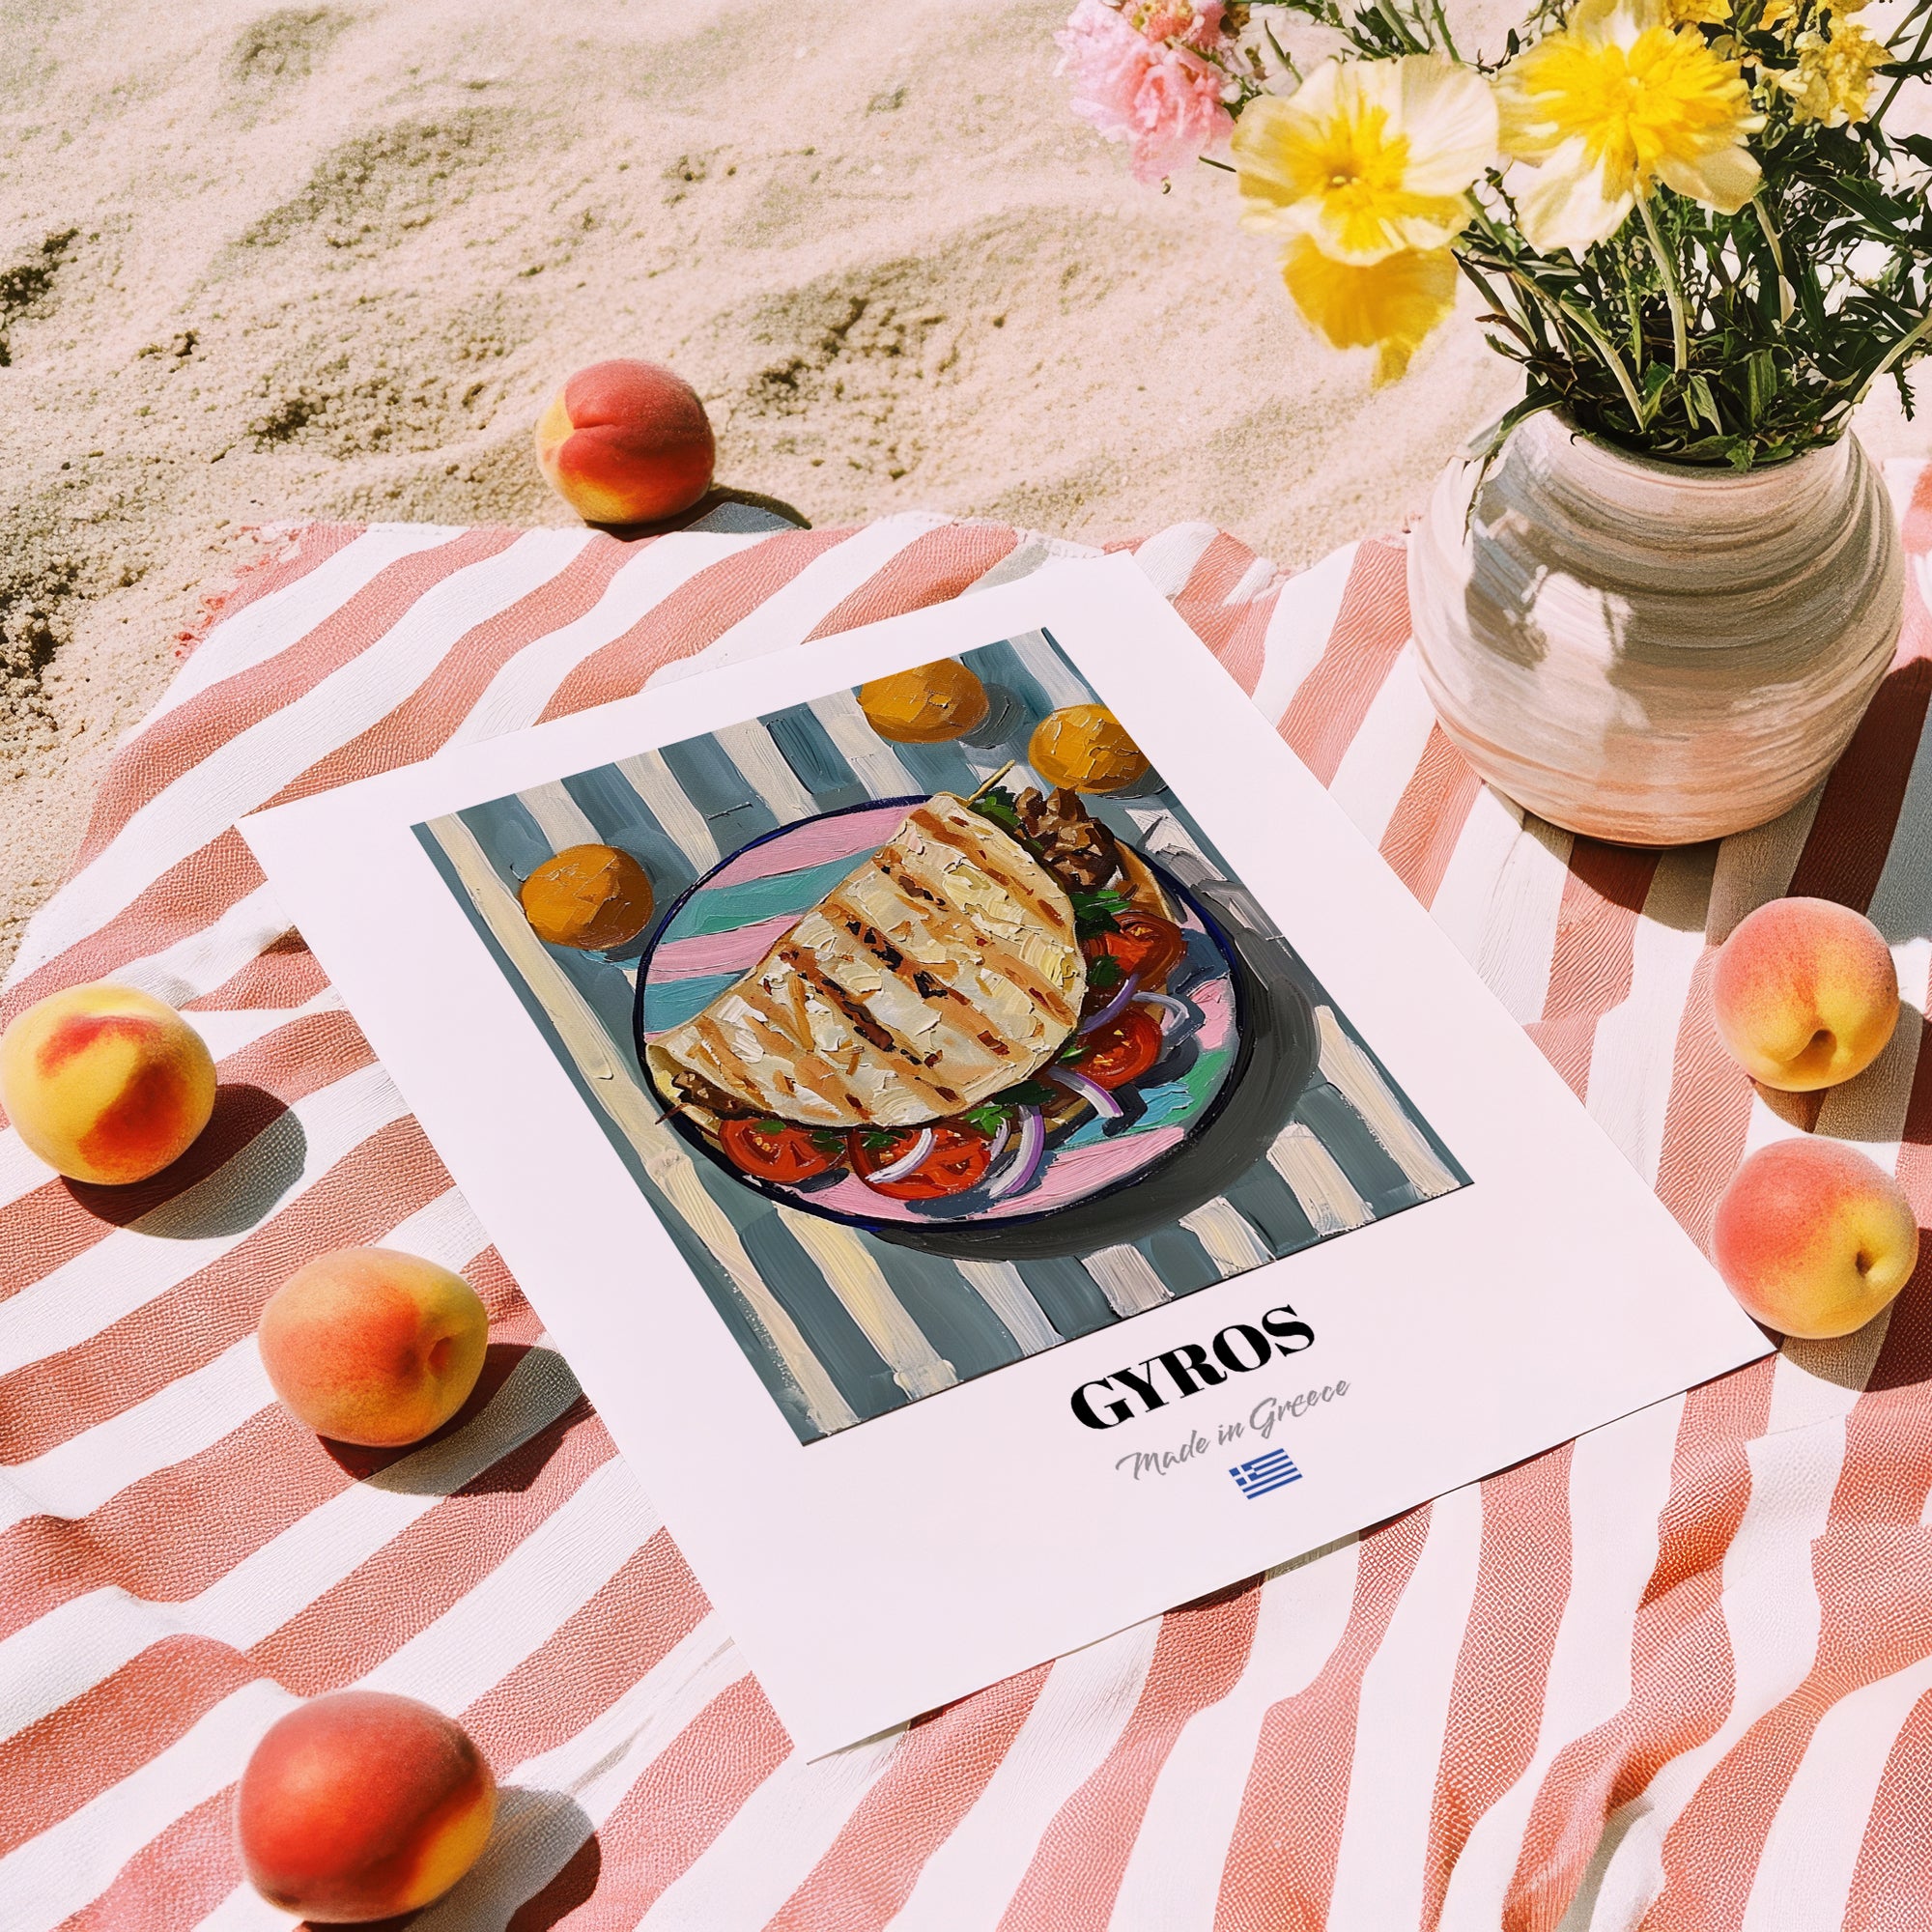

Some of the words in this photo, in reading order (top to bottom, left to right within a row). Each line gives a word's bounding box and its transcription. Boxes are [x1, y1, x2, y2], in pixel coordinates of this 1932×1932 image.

[1070, 1304, 1316, 1431] GYROS
[1115, 1429, 1211, 1481] Made
[1218, 1423, 1245, 1446] in
[1249, 1378, 1351, 1440] Greece
